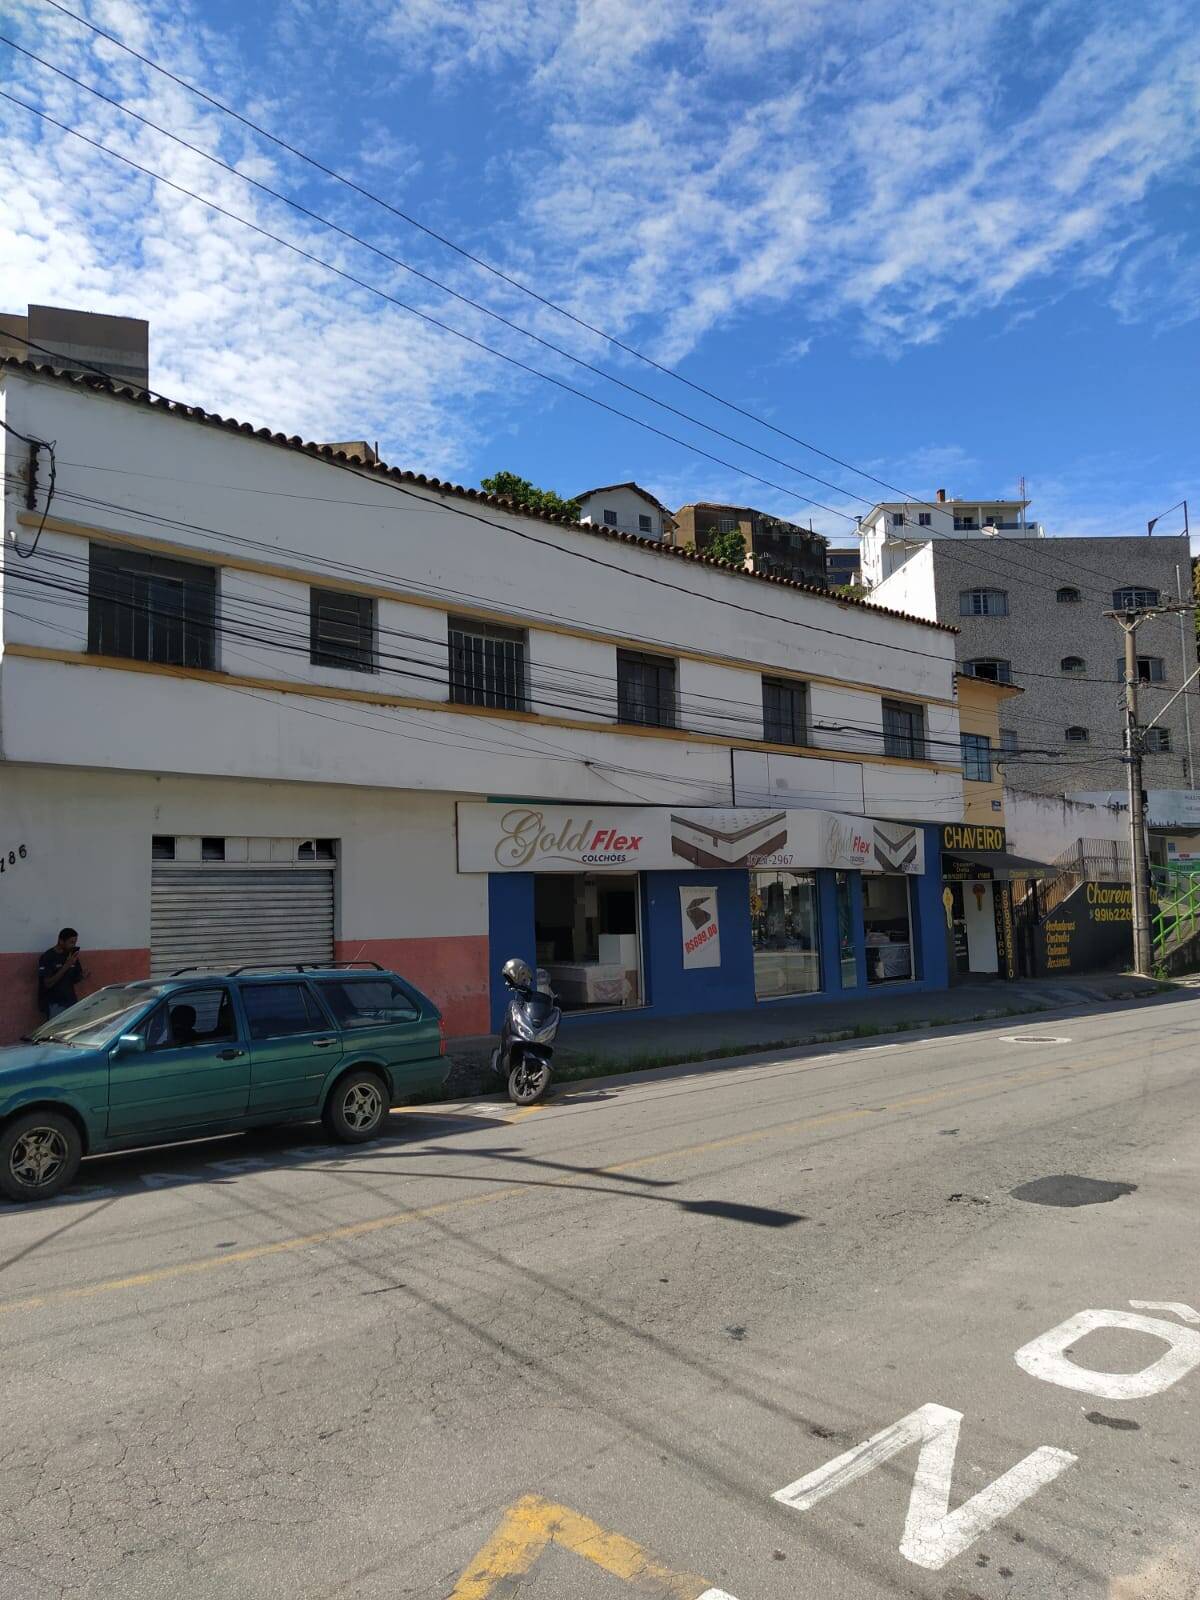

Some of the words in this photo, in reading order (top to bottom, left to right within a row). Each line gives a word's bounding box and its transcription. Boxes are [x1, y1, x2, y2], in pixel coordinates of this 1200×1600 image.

[494, 809, 593, 867] Gold
[590, 829, 644, 851] Flex
[944, 825, 1002, 850] CHAVEIRO
